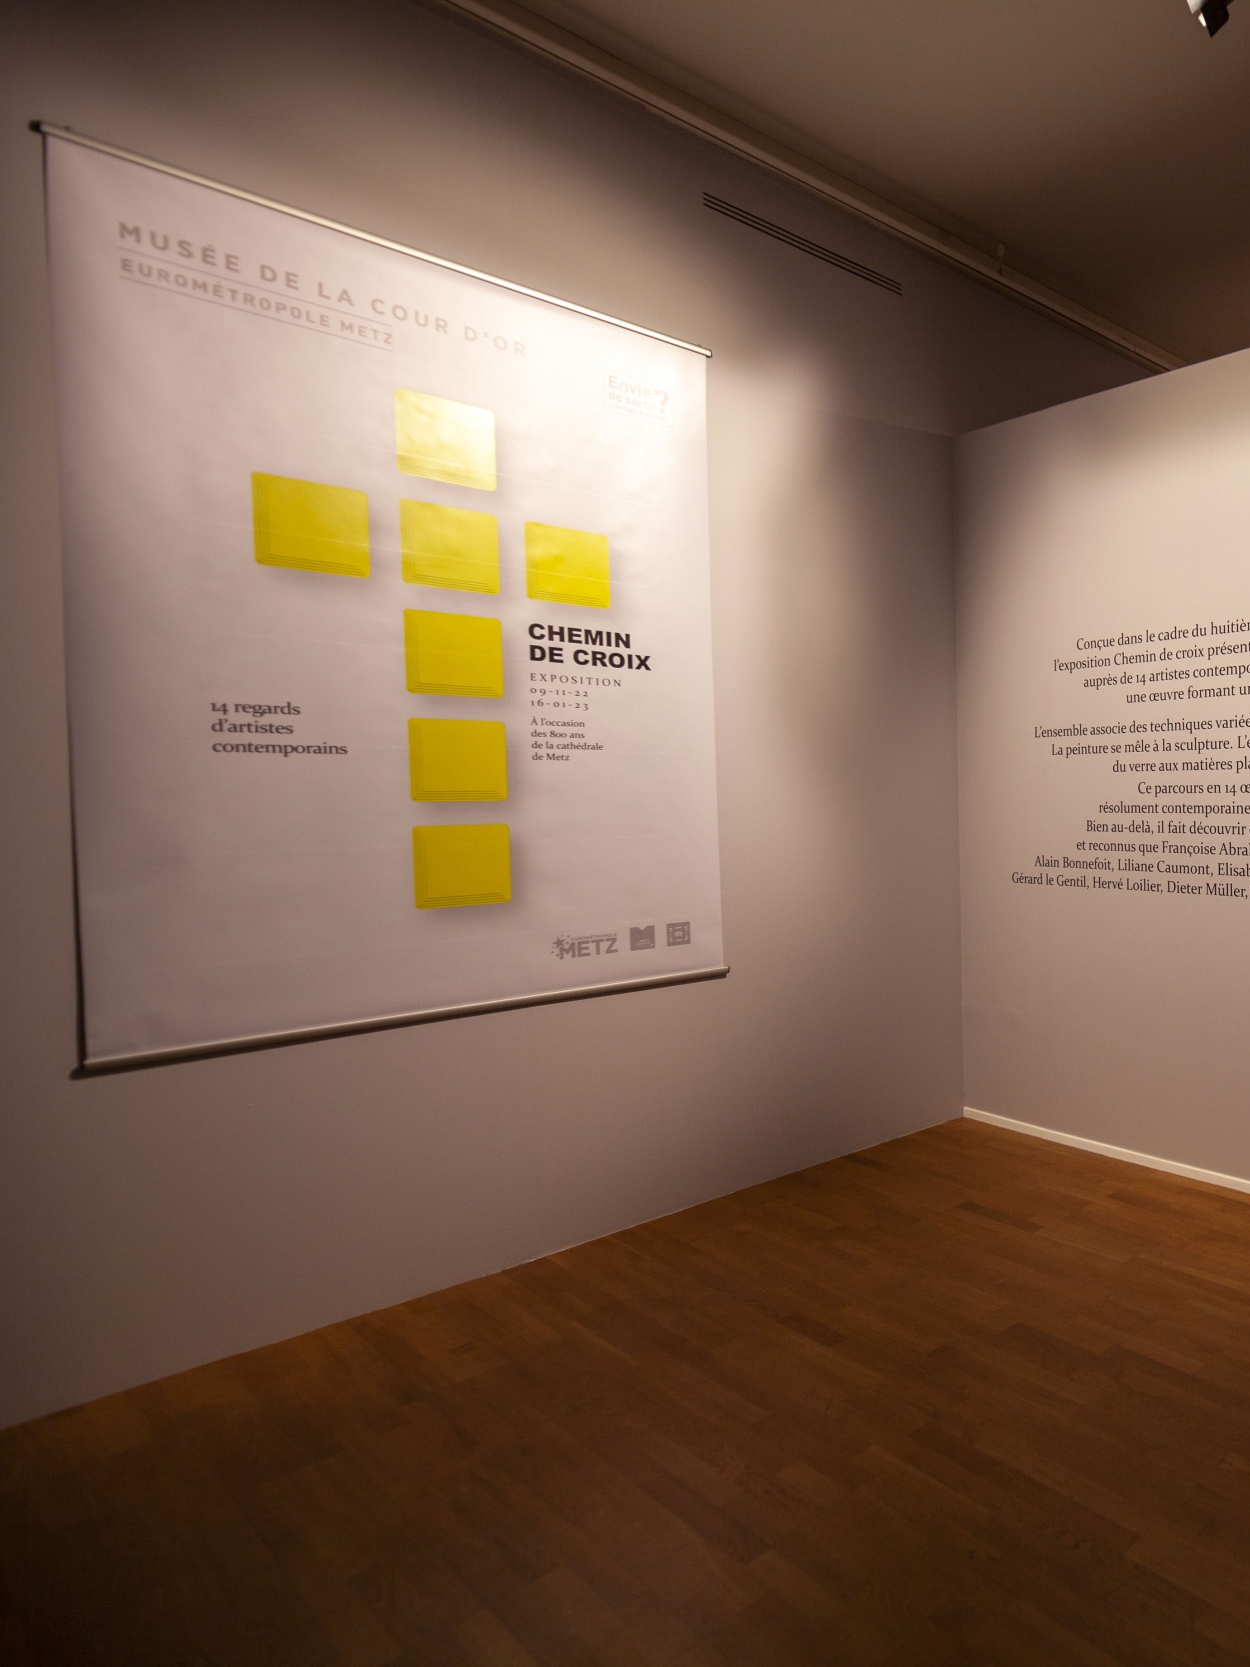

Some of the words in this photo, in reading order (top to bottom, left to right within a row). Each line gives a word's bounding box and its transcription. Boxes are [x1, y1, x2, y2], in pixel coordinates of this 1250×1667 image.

[118, 221, 241, 273] MUSÉE
[259, 263, 300, 290] DE
[317, 281, 353, 306] LA
[371, 298, 448, 334] COUR
[464, 325, 526, 357] D'OR
[120, 257, 330, 327] EUROMÉTROPOLE
[340, 320, 393, 344] METZ
[608, 374, 651, 399] Envie
[608, 391, 622, 402] de
[528, 623, 631, 649] CHEMIN
[1076, 637, 1116, 651] Conçue
[1117, 632, 1143, 646] dans
[1145, 629, 1156, 642] le
[1157, 625, 1190, 641] cadre
[1191, 623, 1207, 637] du
[529, 645, 564, 663] DE
[573, 649, 651, 671] CROIX
[1053, 655, 1111, 673] l'exposition
[1113, 649, 1157, 665] Chemin
[1158, 647, 1174, 661] de
[1175, 644, 1205, 659] croix
[530, 673, 622, 687] EXPOSITION
[530, 687, 589, 697] 09-11-22
[1126, 693, 1147, 703] une
[1148, 690, 1185, 701] œuvre
[1187, 684, 1236, 699] formant
[210, 702, 228, 716] 14
[234, 701, 301, 718] regards
[530, 699, 589, 711] 16-01-23
[211, 719, 294, 734] d'artistes
[531, 716, 538, 726] À
[541, 718, 585, 728] l'occasion
[1034, 723, 1089, 738] L'ensemble
[1089, 721, 1127, 735] associe
[1128, 719, 1148, 733] des
[1149, 717, 1213, 734] techniques
[531, 729, 547, 738] des
[550, 730, 567, 739] 800
[569, 731, 585, 739] ans
[212, 742, 348, 757] contemporains
[532, 741, 543, 750] de
[546, 741, 554, 749] la
[556, 742, 603, 751] cathédrale
[1051, 743, 1064, 755] La
[1065, 742, 1109, 758] peinture
[1110, 744, 1122, 753] se
[1124, 738, 1151, 753] mêle
[1152, 739, 1160, 752] à
[1161, 738, 1173, 751] la
[1174, 736, 1234, 754] sculpture.
[532, 752, 544, 761] de
[546, 753, 570, 762] Metz
[1137, 781, 1153, 794] Ce
[1154, 784, 1205, 797] parcours
[1206, 784, 1222, 793] en
[1224, 783, 1238, 796] 14
[1098, 800, 1160, 813] résolument
[1086, 819, 1109, 832] Bien
[1110, 819, 1154, 835] au-delà,
[1157, 819, 1165, 833] il
[1167, 819, 1187, 834] fait
[1188, 820, 1247, 835] découvrir
[1076, 840, 1087, 850] et
[1088, 842, 1137, 852] reconnus
[1138, 843, 1160, 856] que
[1161, 840, 1217, 857] Françoise
[1033, 854, 1060, 867] Alain
[1062, 856, 1115, 872] Bonnefoit,
[1117, 858, 1155, 872] Liliane
[1156, 859, 1214, 877] Caumont,
[1011, 871, 1044, 885] Gérard
[1045, 872, 1055, 885] le
[1056, 874, 1090, 889] Gentil,
[1092, 876, 1124, 890] Hervé
[1126, 877, 1164, 894] Loilier,
[1166, 880, 1203, 894] Dieter
[1205, 882, 1249, 900] Müller,
[559, 937, 618, 959] METZ
